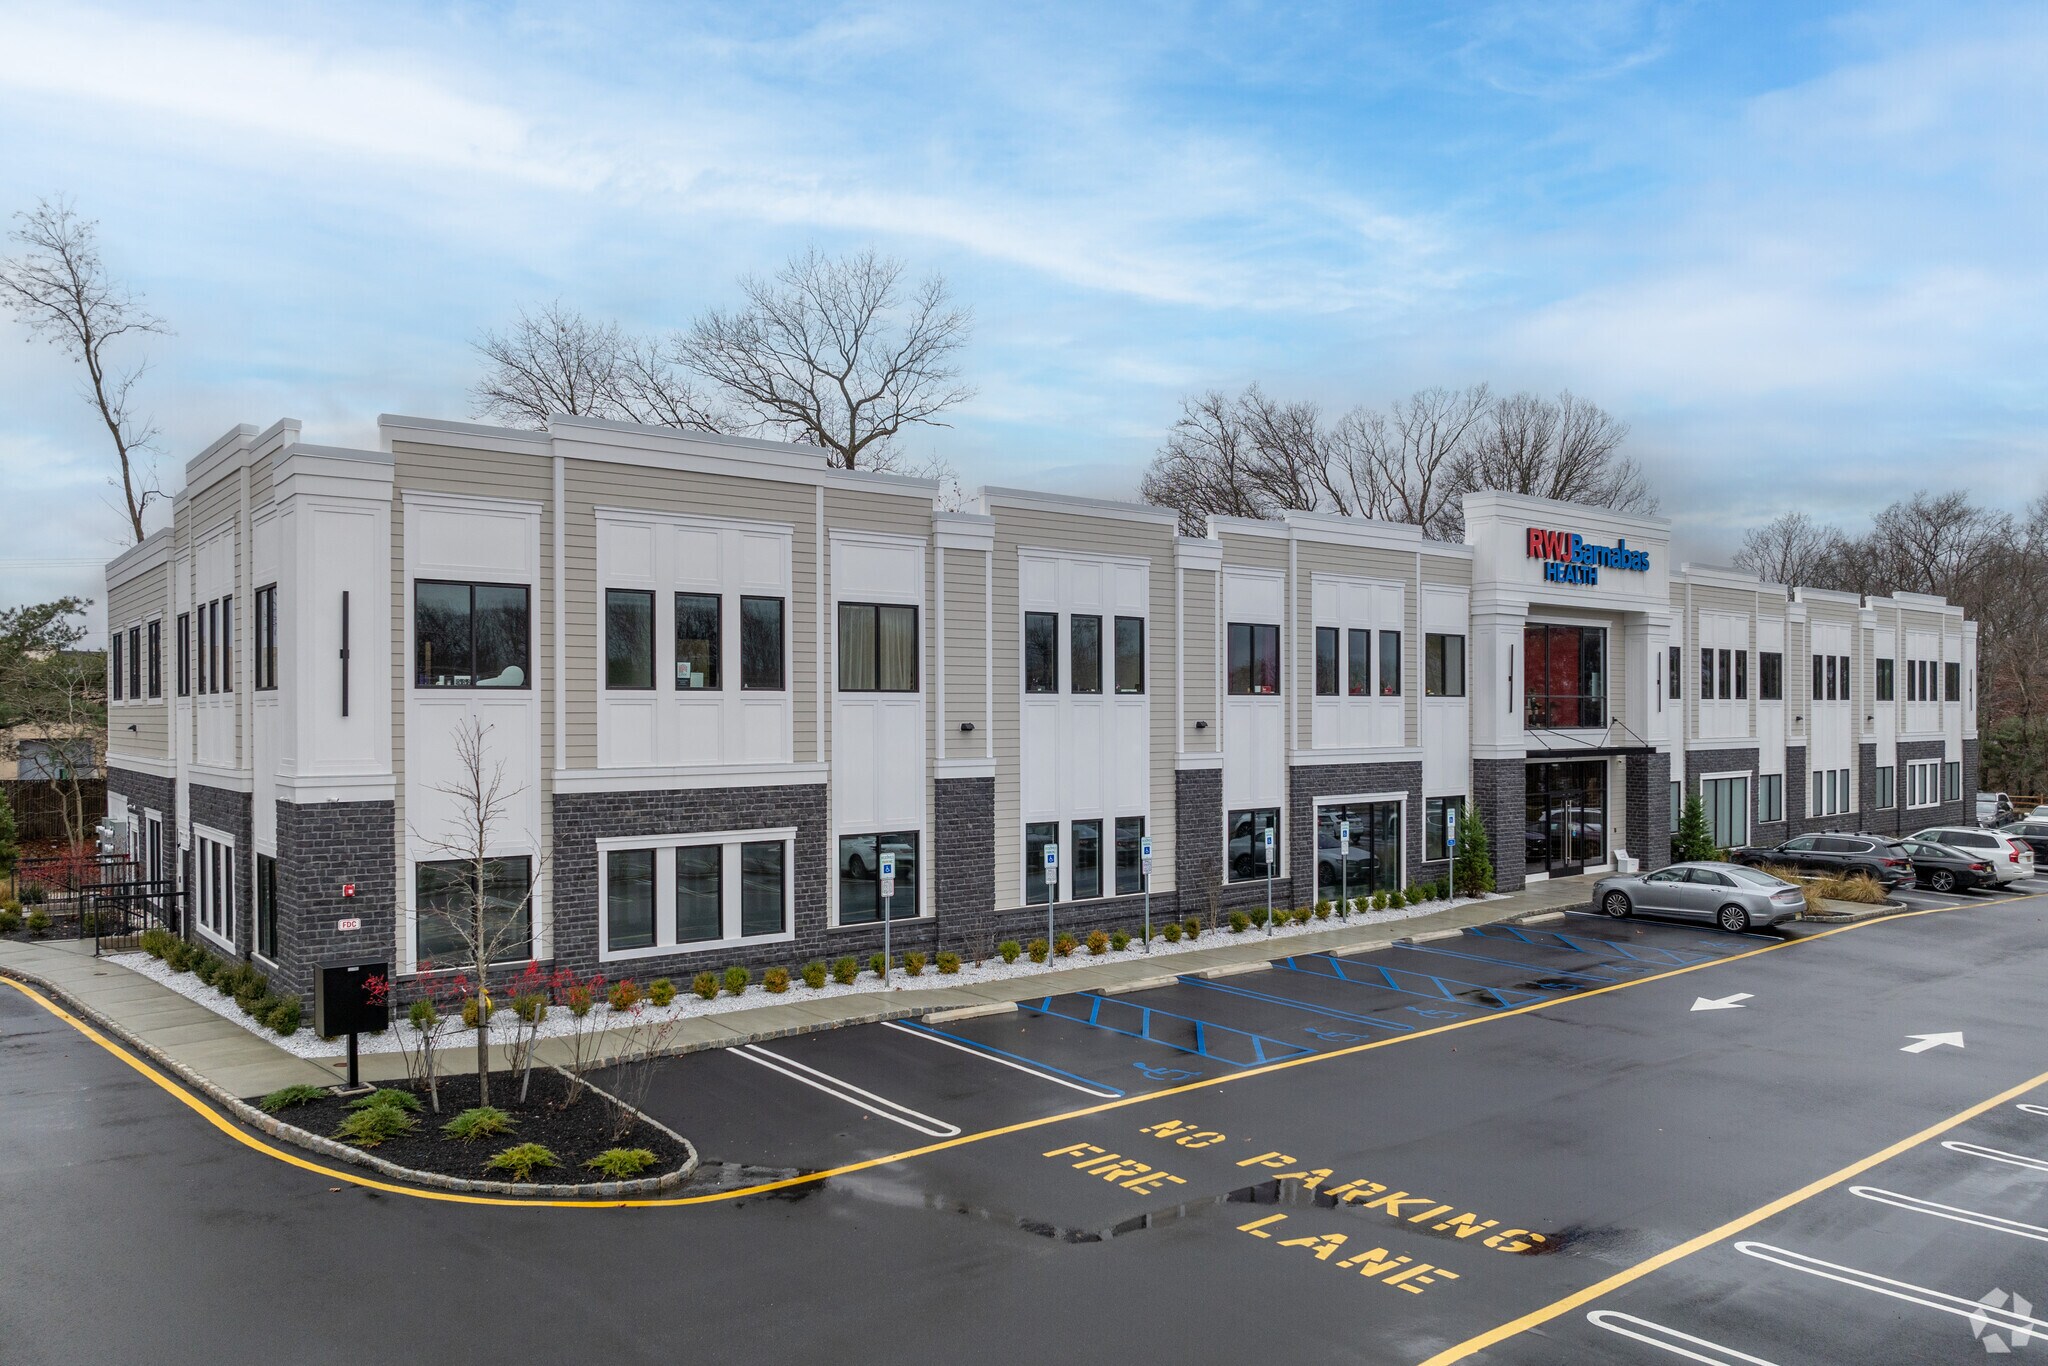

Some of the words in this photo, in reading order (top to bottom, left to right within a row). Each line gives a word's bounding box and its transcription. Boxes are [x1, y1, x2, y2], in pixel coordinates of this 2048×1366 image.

[1544, 562, 1598, 585] HEALTH
[342, 920, 357, 928] FDC
[1042, 1142, 1187, 1195] FIRE
[1236, 1213, 1460, 1294] LANE
[1140, 1119, 1226, 1149] NO
[1236, 1151, 1546, 1253] PARKING
